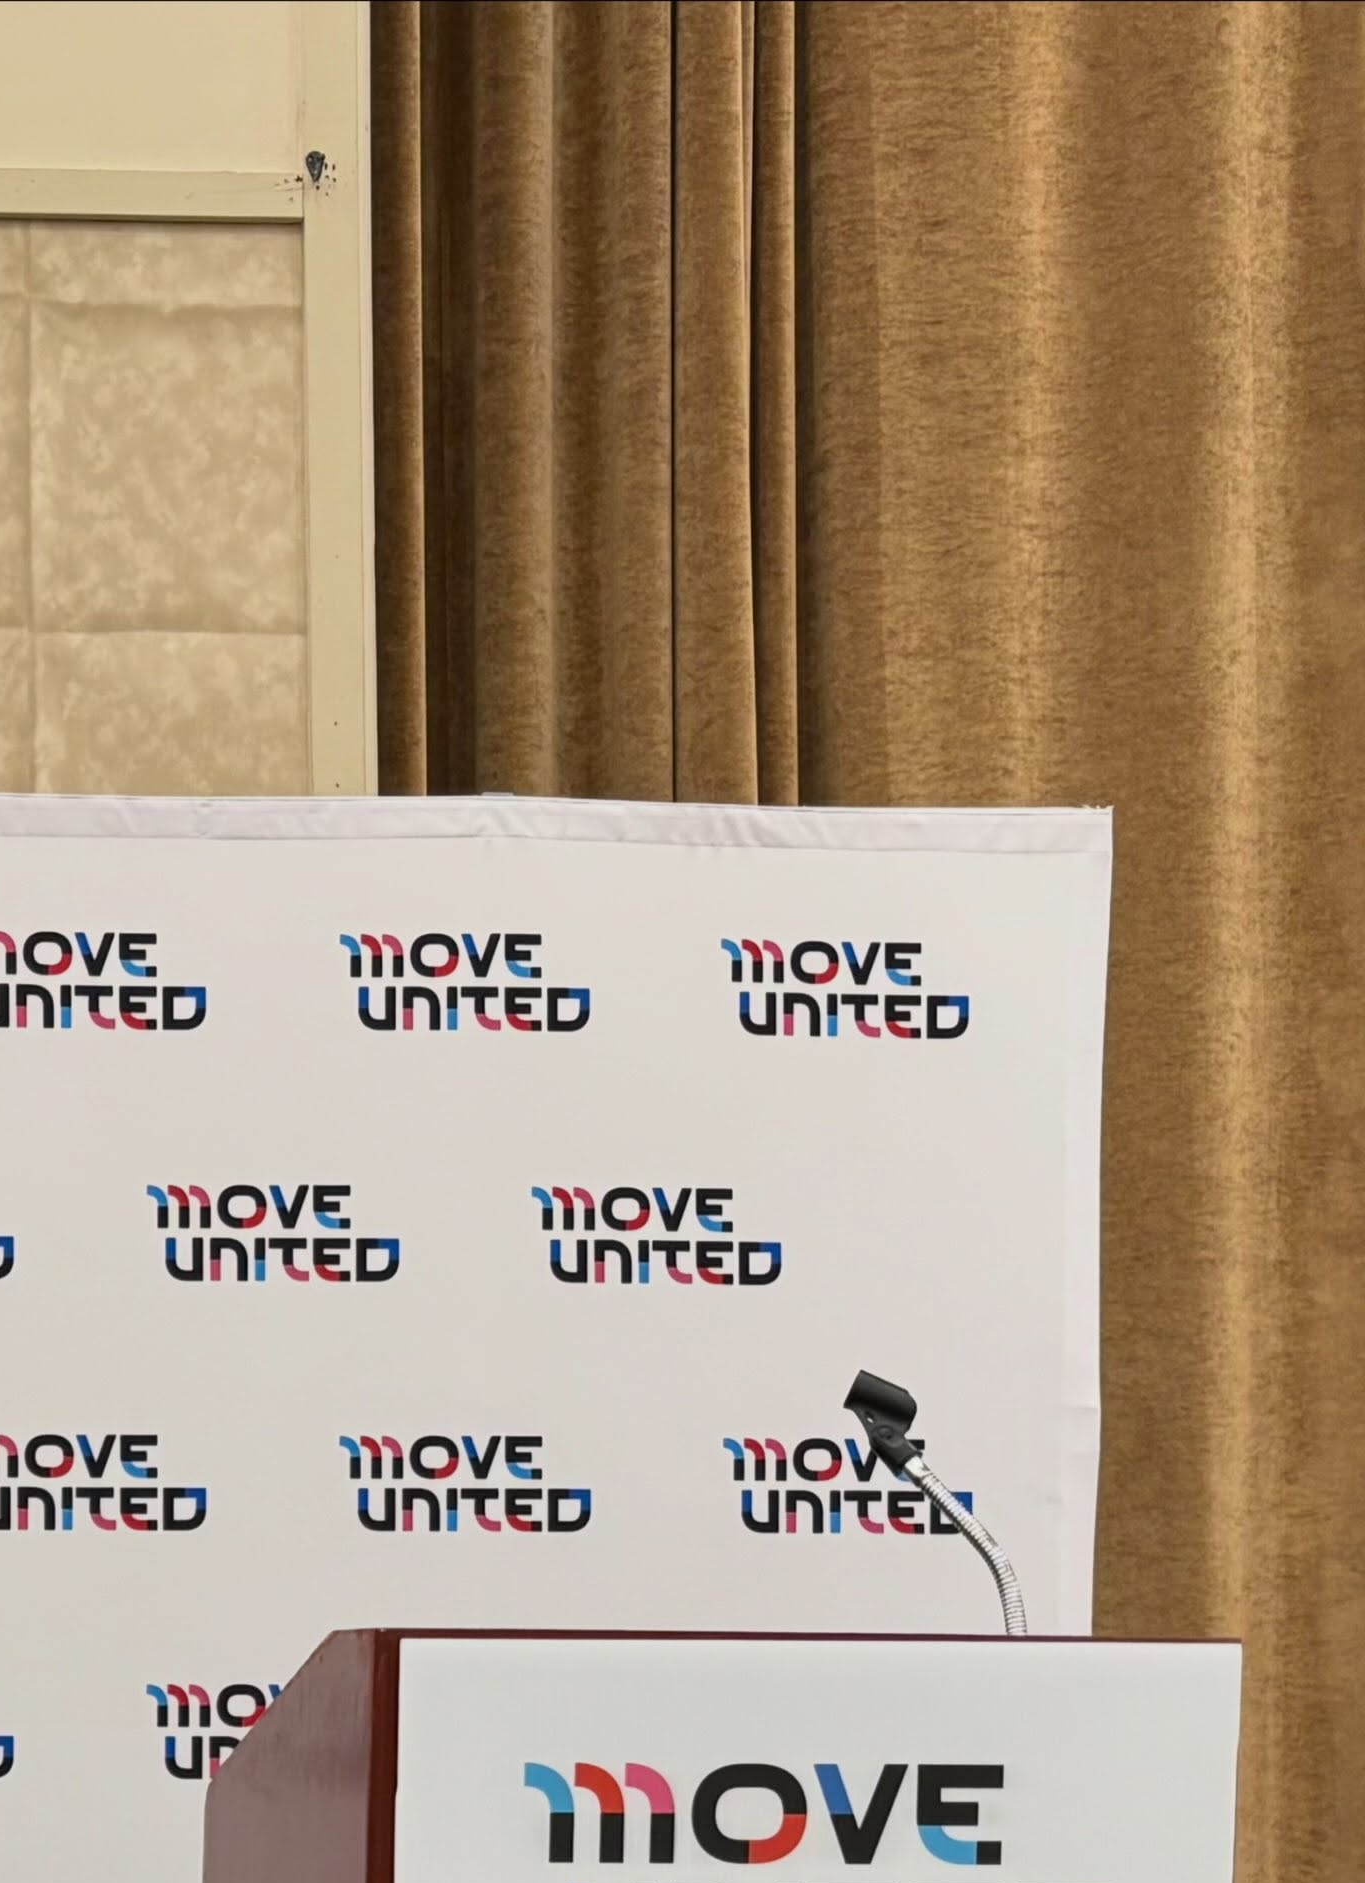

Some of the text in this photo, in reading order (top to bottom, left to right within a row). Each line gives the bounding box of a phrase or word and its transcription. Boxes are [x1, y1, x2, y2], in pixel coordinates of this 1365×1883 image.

[339, 933, 542, 978] MOVE
[721, 940, 922, 986] MOVE
[358, 986, 591, 1032] UNITED
[740, 992, 970, 1039] UNITED
[146, 1185, 351, 1229] MOVE
[531, 1187, 734, 1232] MOVE
[166, 1237, 400, 1282] UNITED
[550, 1240, 782, 1285] UNITED
[339, 1436, 543, 1480] MOVE
[358, 1488, 592, 1532] UNITED
[524, 1763, 1005, 1865] MOVE
